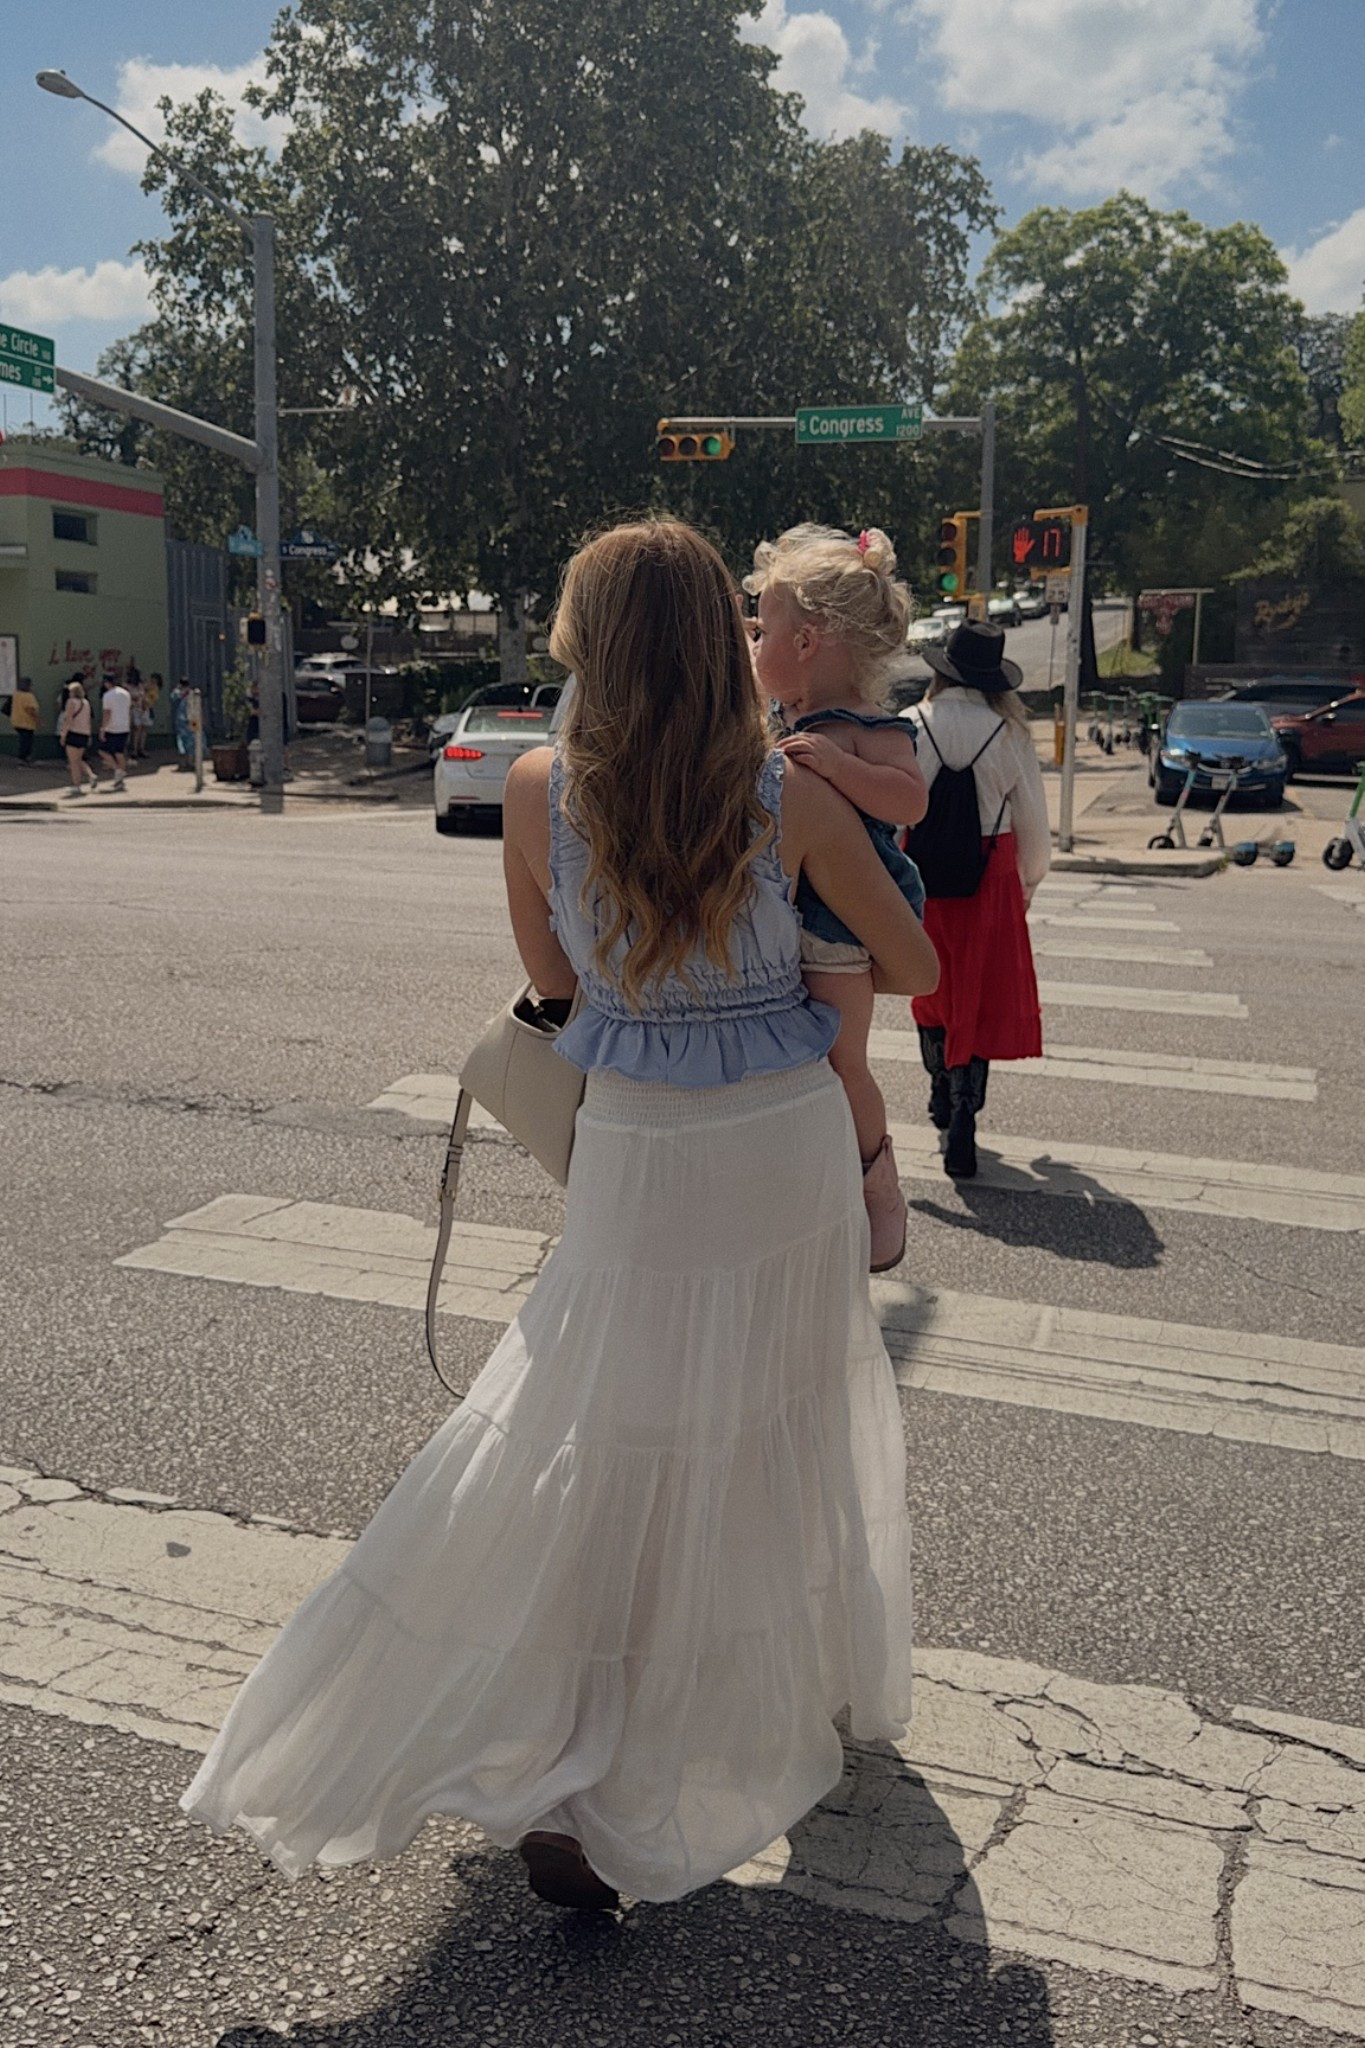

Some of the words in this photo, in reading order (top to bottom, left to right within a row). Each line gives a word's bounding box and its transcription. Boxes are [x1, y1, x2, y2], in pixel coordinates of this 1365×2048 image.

[11, 333, 39, 357] Circle
[901, 407, 920, 419] AVE
[809, 416, 884, 437] Congress
[896, 424, 919, 436] 1200
[289, 544, 328, 557] Congress
[1043, 527, 1060, 557] 17
